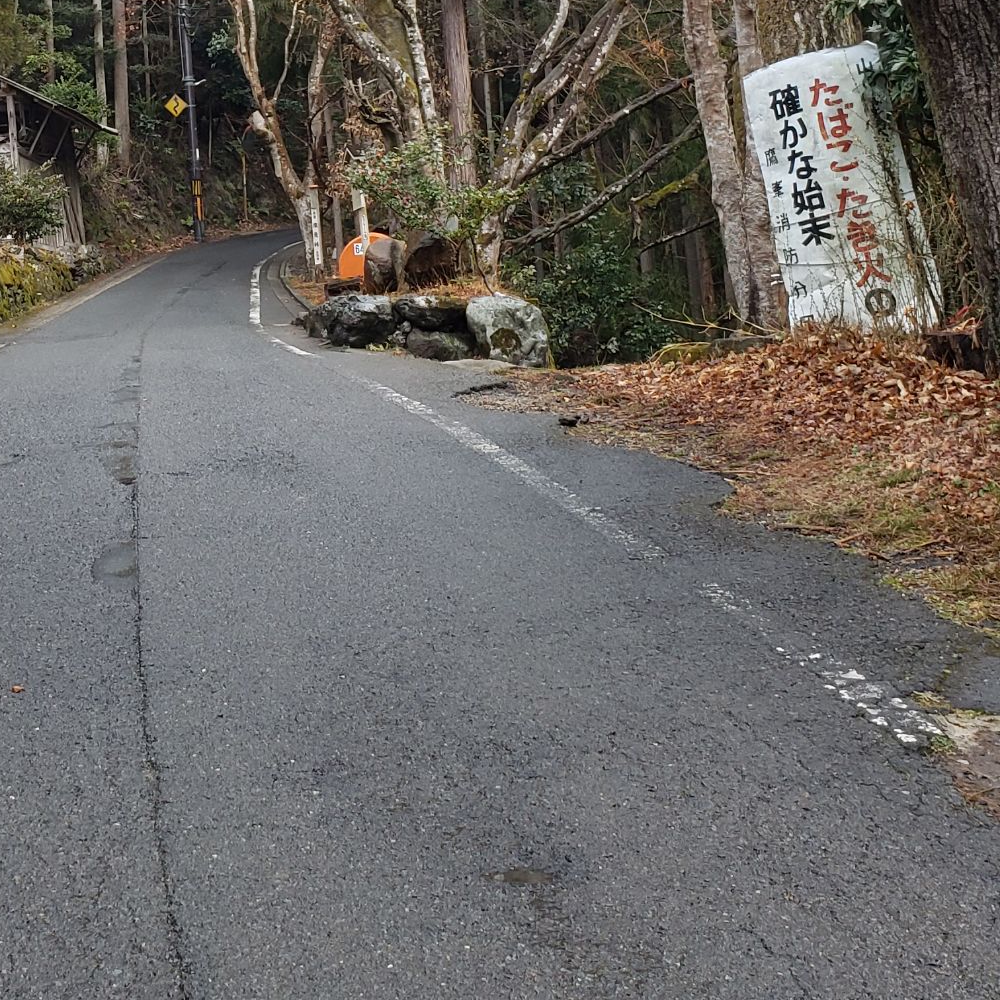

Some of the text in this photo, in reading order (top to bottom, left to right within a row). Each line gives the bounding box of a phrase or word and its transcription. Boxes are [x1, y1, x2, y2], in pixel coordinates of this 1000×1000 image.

[769, 84, 835, 247] 確かな始末
